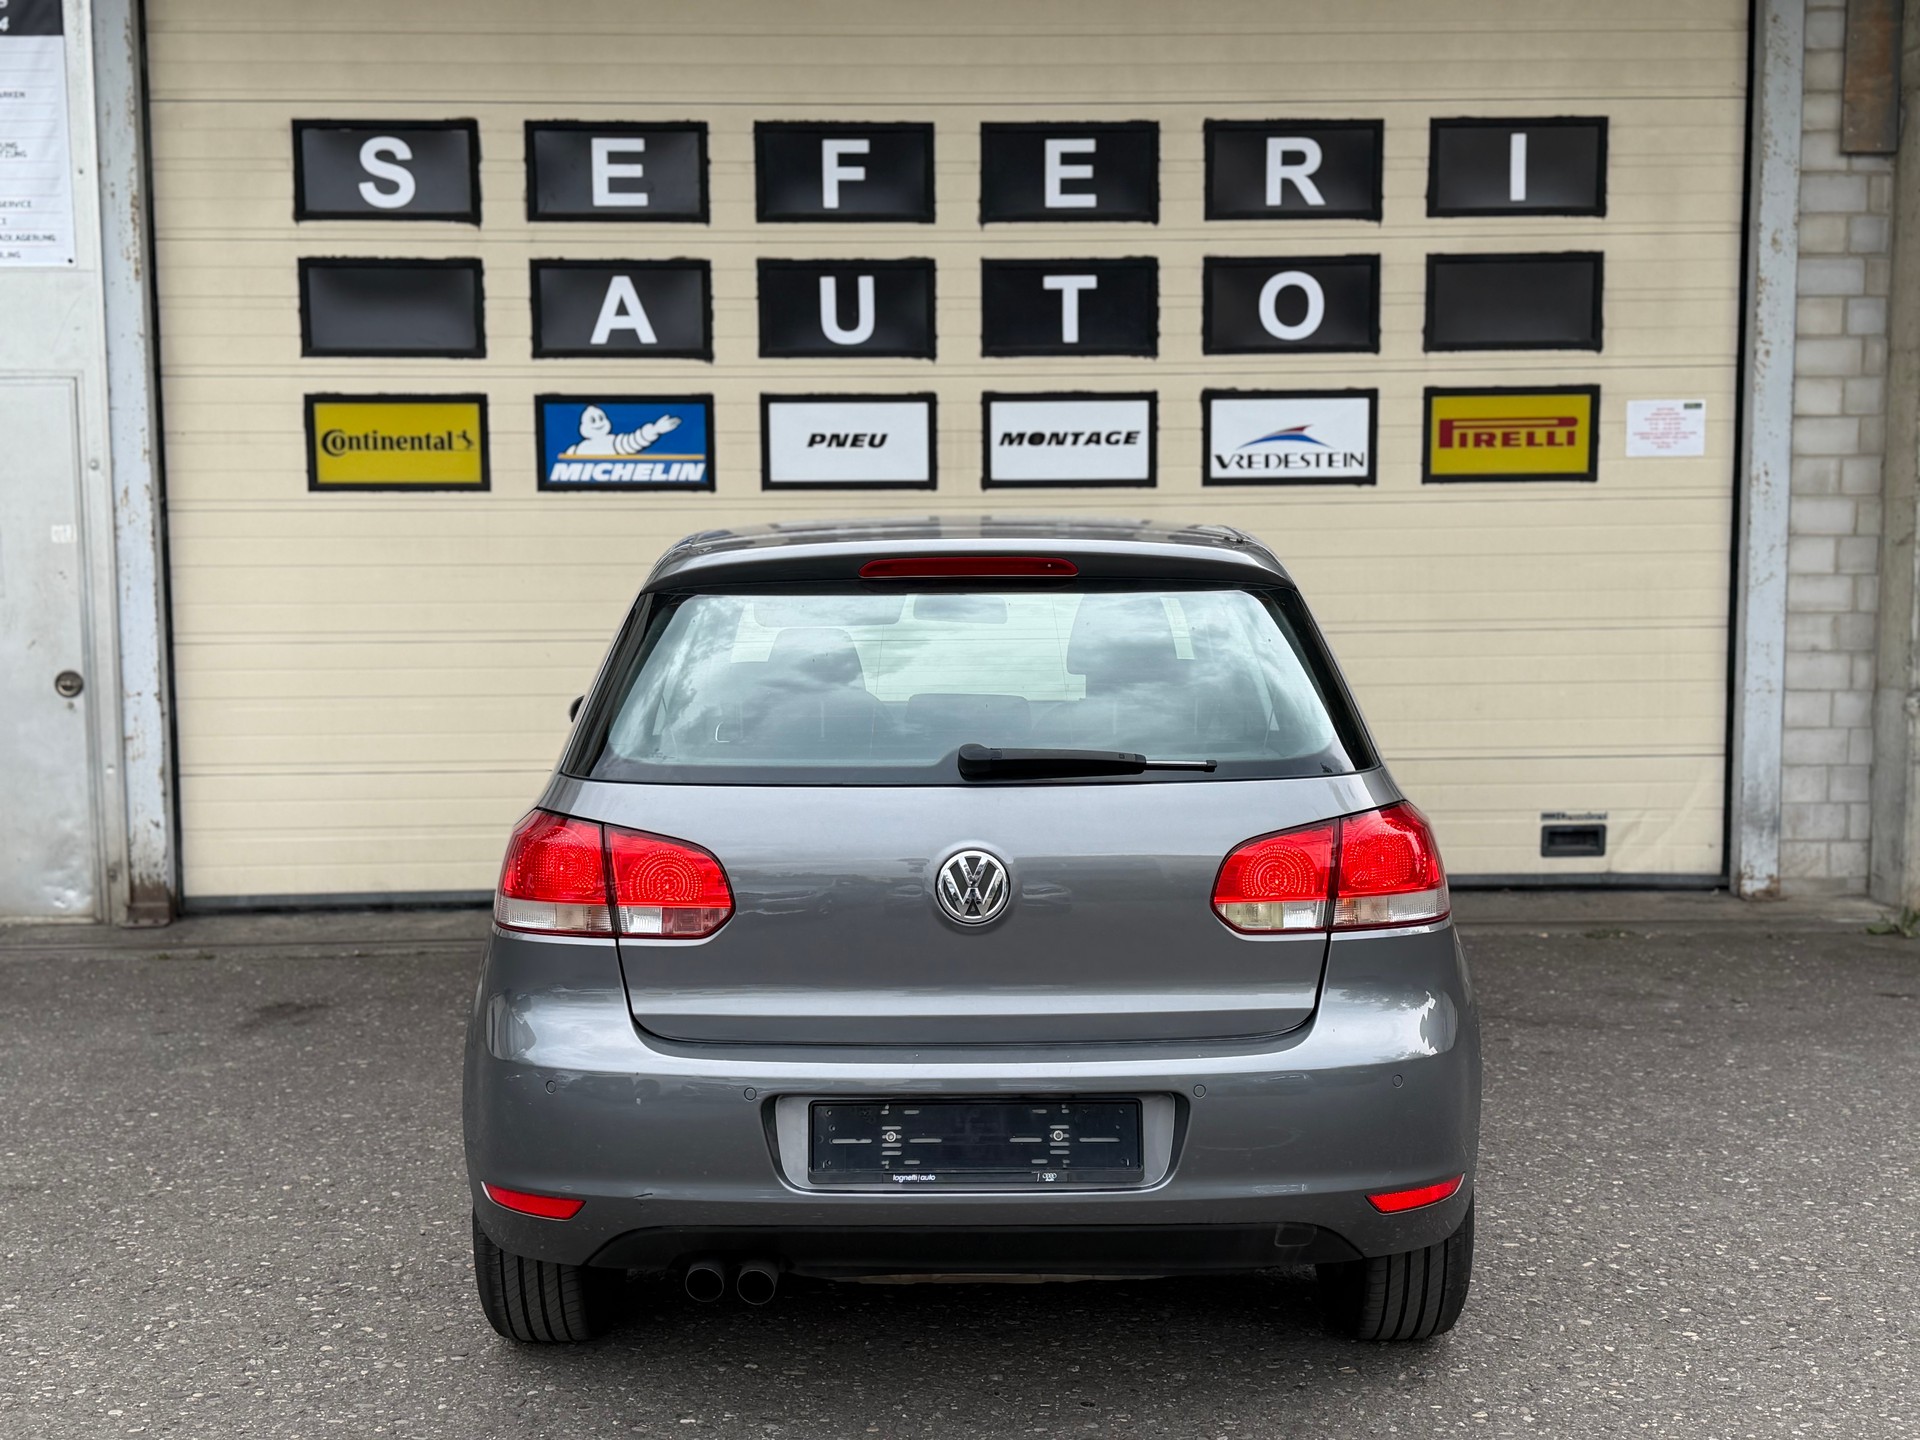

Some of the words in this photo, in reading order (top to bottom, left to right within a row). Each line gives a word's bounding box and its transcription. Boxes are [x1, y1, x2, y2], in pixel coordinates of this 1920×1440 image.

[807, 433, 888, 448] PNEU
[1000, 431, 1141, 446] MONTAGE
[1438, 417, 1579, 449] PIRELLI
[321, 429, 453, 457] Continental
[1214, 452, 1365, 470] VREDESTEIN
[550, 463, 706, 482] MICHELIN
